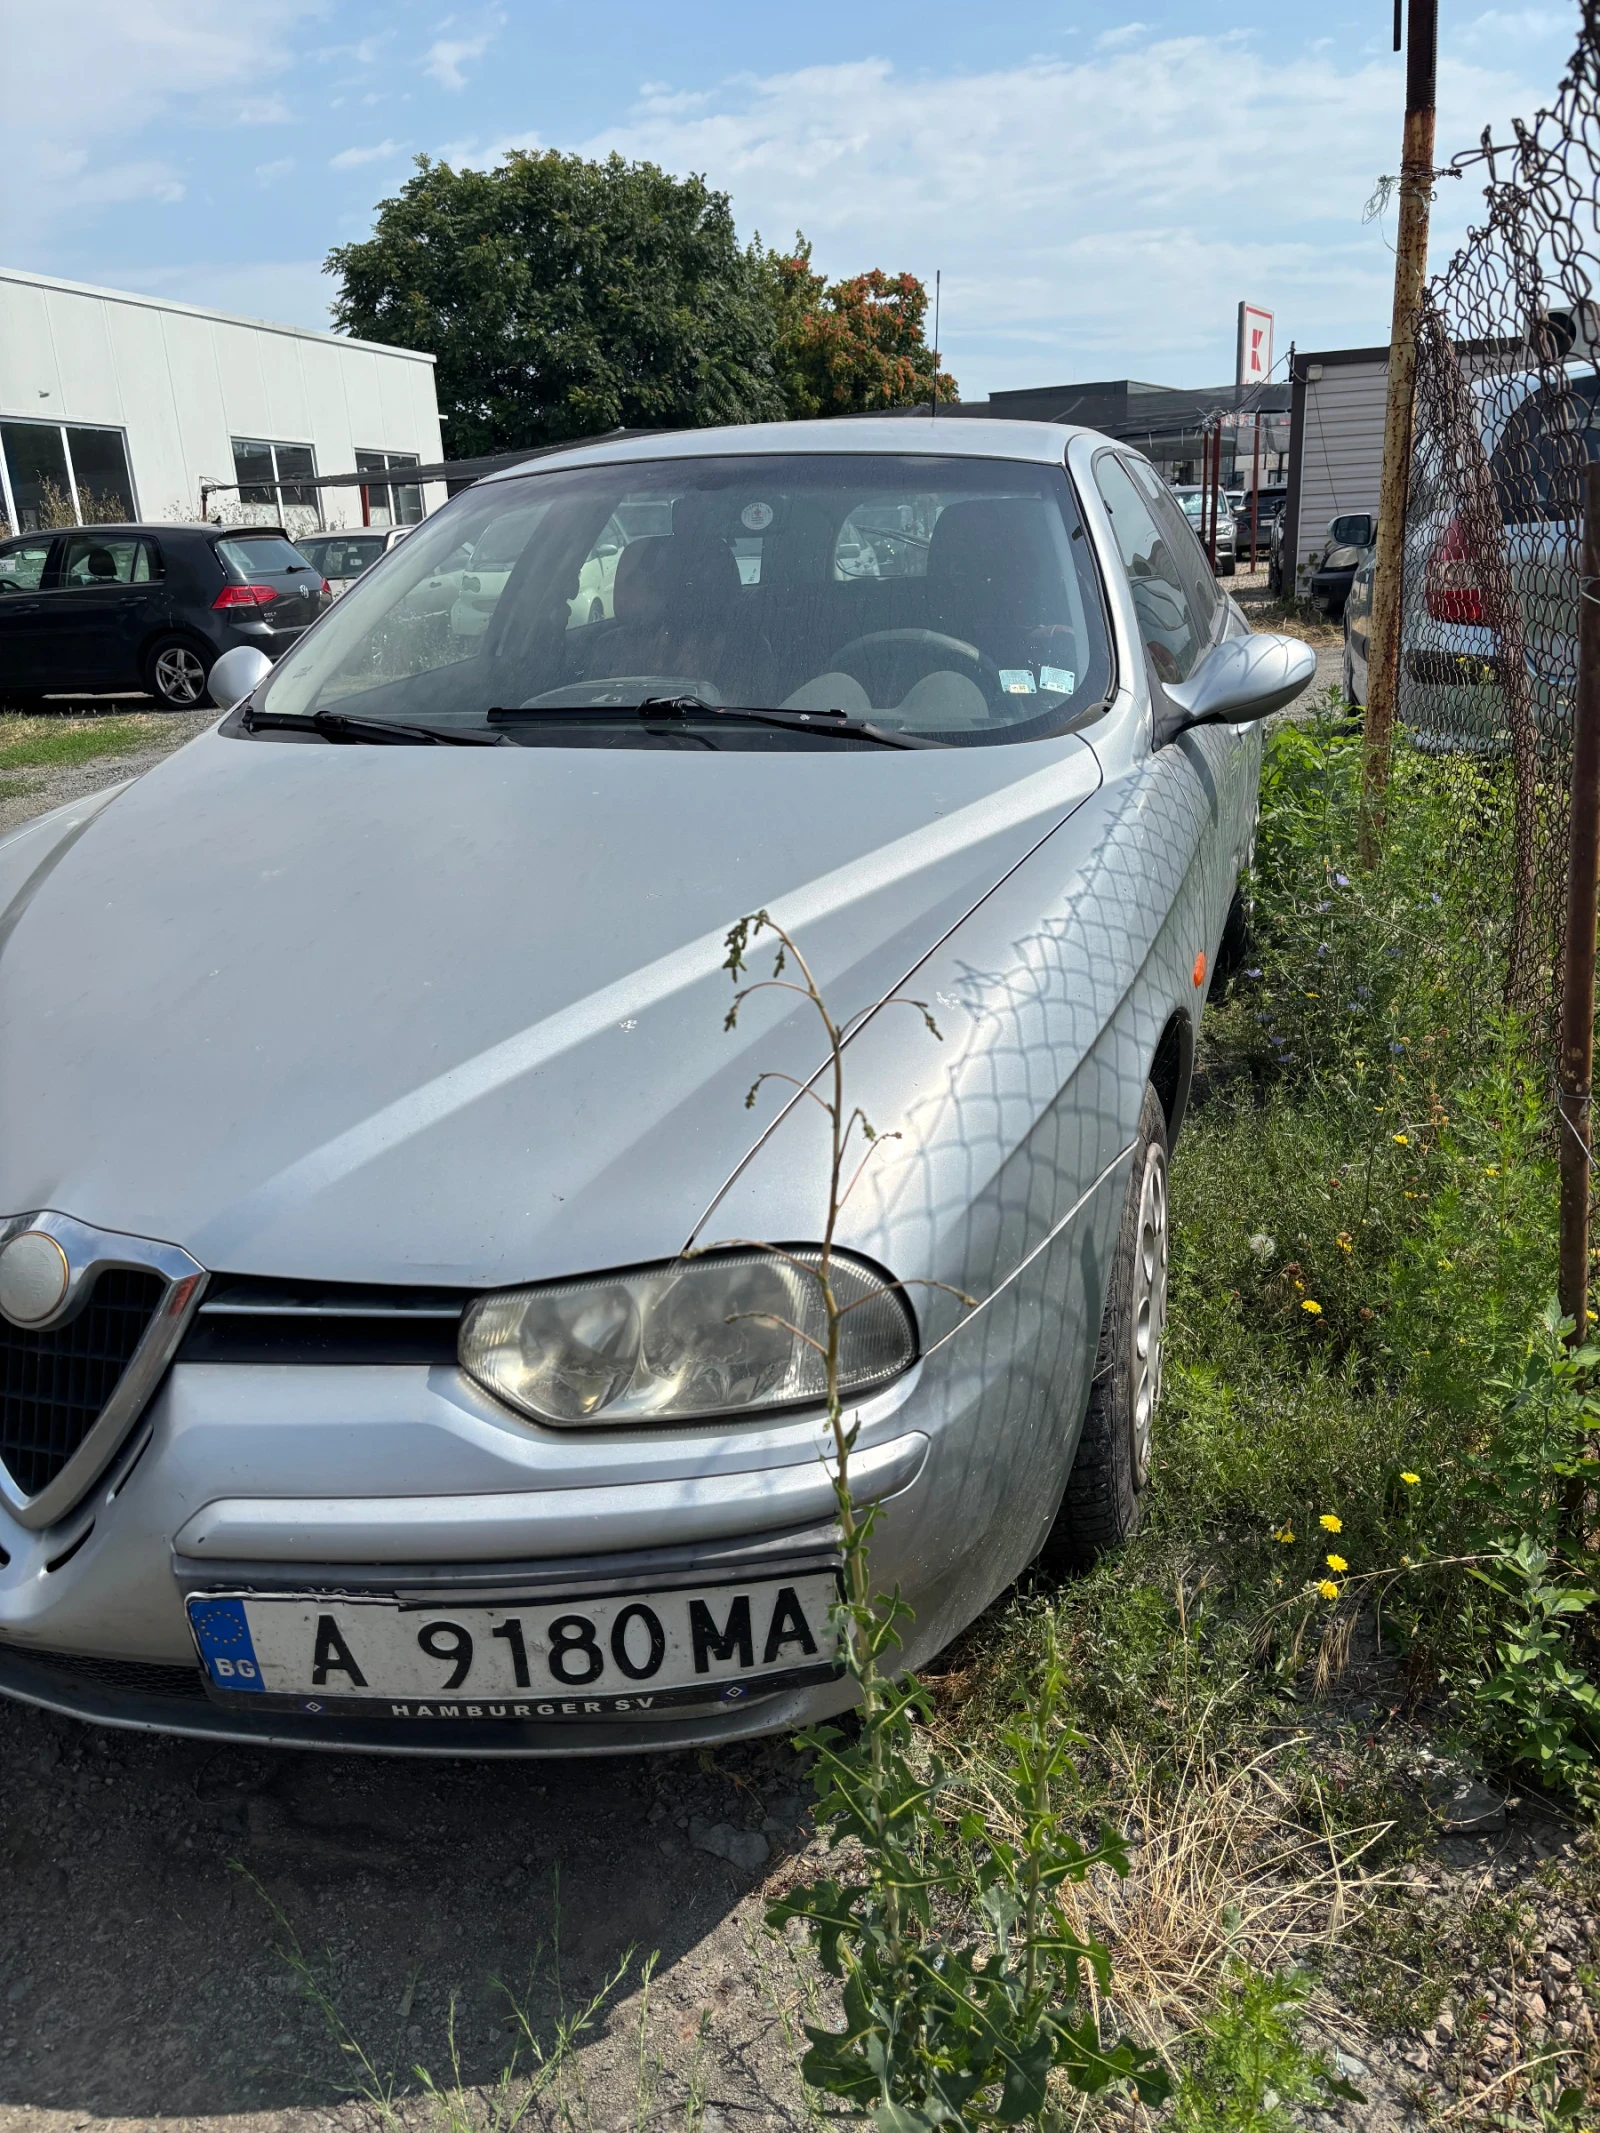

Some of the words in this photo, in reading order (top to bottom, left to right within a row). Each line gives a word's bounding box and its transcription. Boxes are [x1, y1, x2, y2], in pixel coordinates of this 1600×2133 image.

[1251, 328, 1264, 372] K
[312, 1614, 369, 1688] A
[417, 1602, 666, 1690] 9180
[688, 1586, 819, 1674] MA
[214, 1657, 256, 1678] BG
[391, 1701, 602, 1719] HAMBURGER
[614, 1697, 654, 1711] SV
